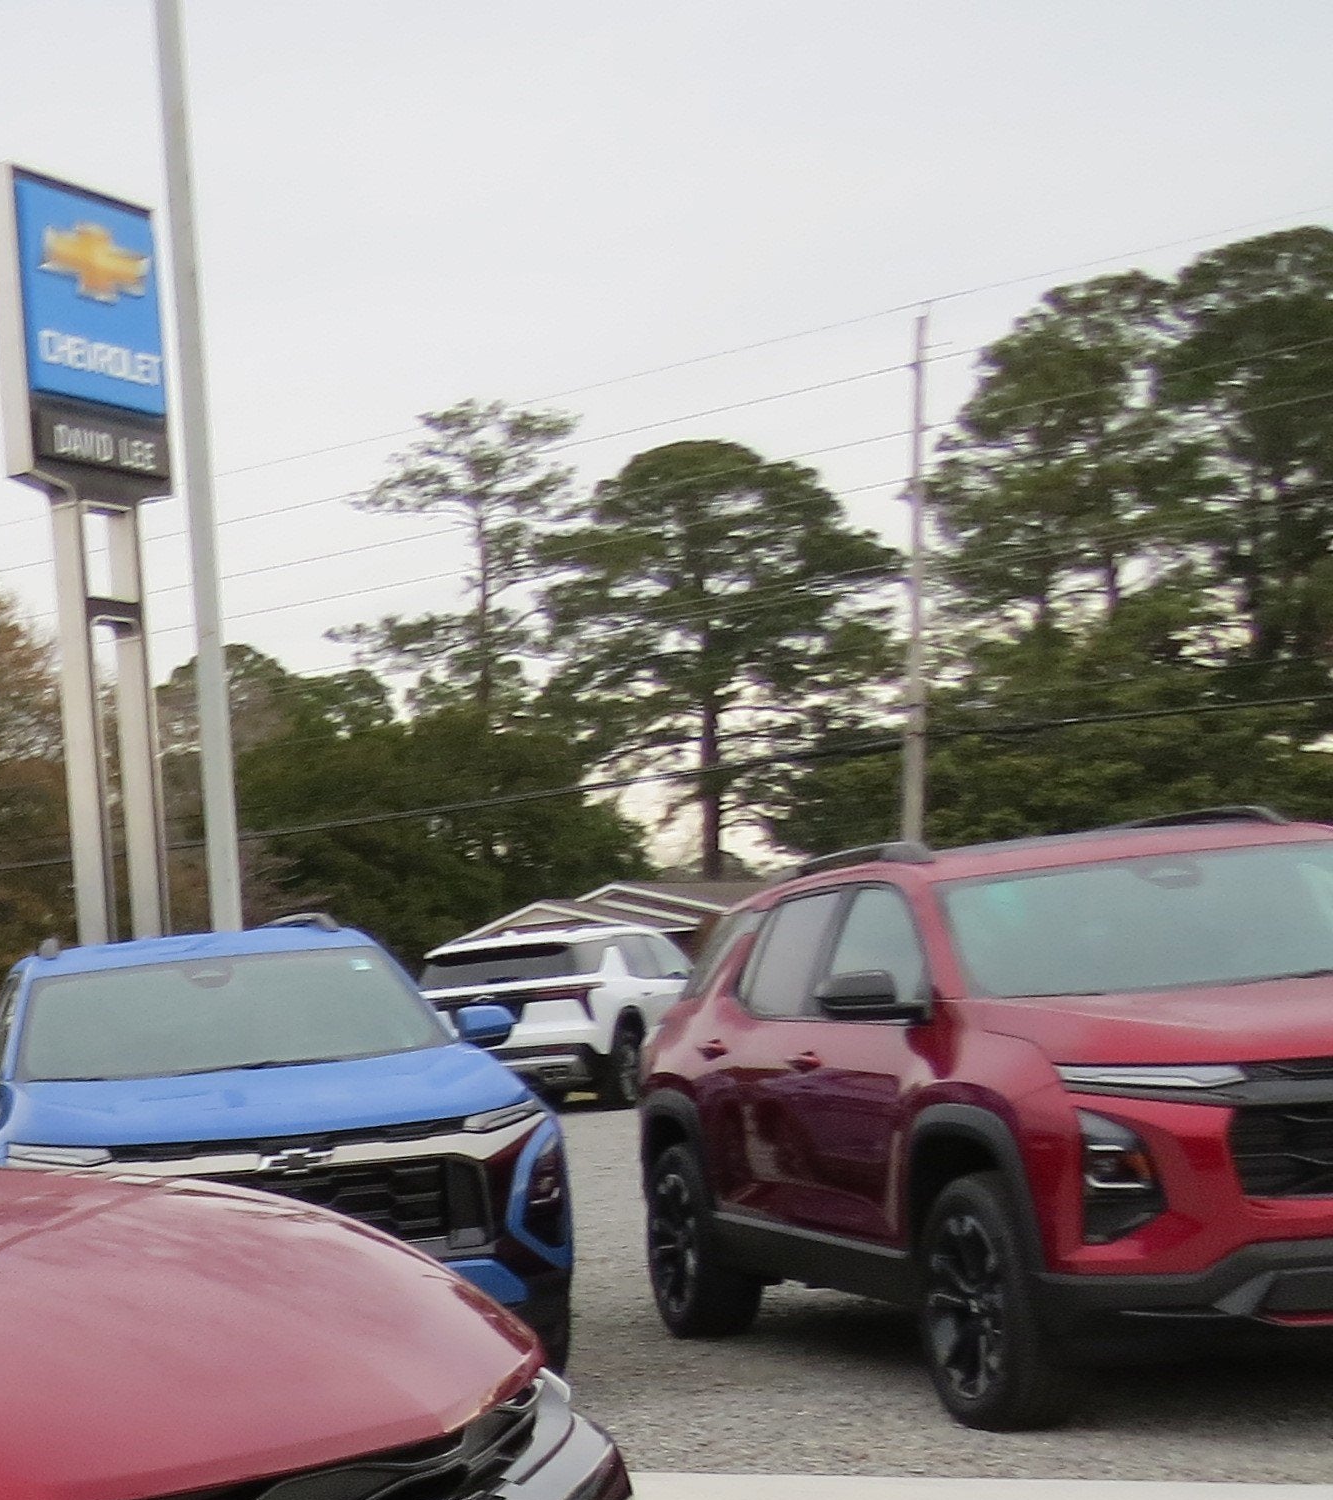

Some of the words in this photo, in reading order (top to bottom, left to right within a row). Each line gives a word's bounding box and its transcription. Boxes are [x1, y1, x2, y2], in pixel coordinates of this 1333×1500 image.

[39, 329, 161, 386] CHEVROLET
[53, 424, 114, 462] DAVID
[118, 436, 157, 472] LEE
